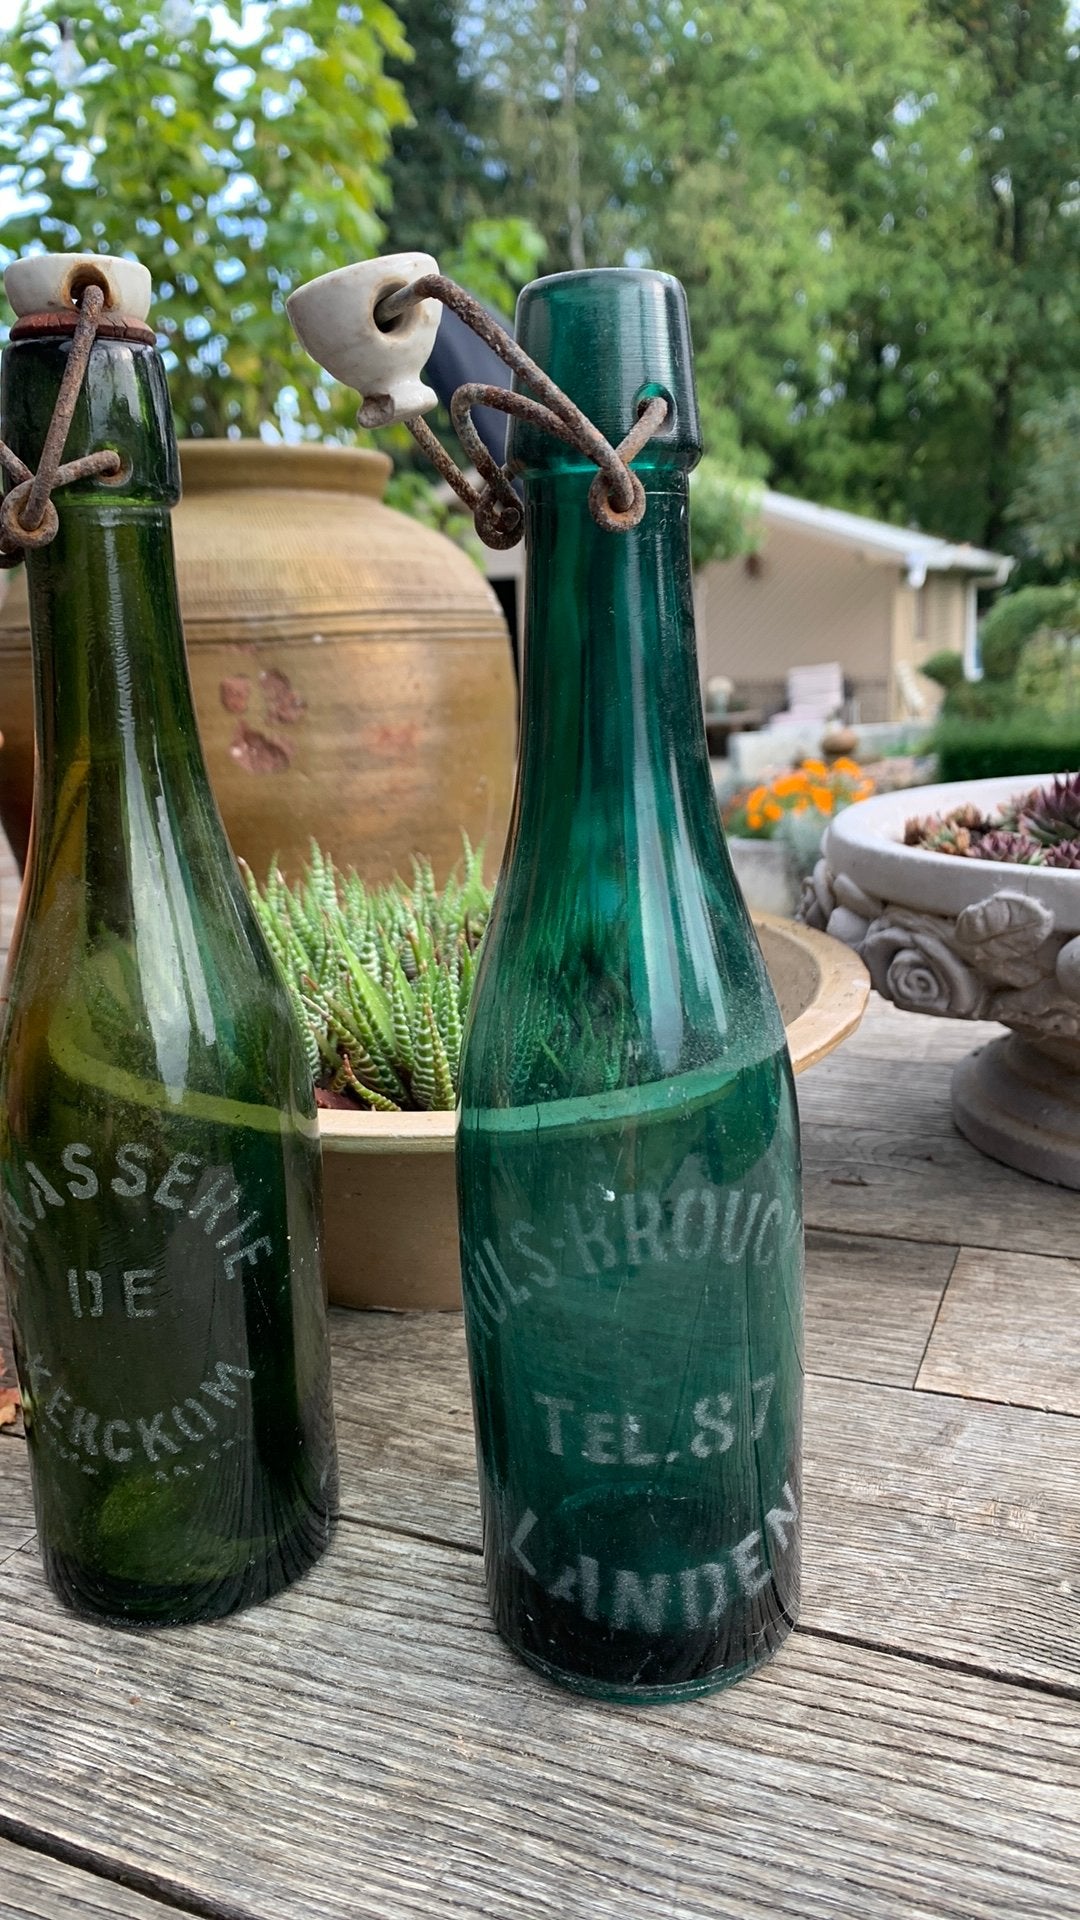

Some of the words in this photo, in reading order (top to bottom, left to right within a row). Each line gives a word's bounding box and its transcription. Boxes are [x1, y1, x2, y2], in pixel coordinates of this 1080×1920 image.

[67, 1268, 157, 1319] DE
[691, 1372, 776, 1459] 87
[510, 1480, 799, 1633] LANDEN
